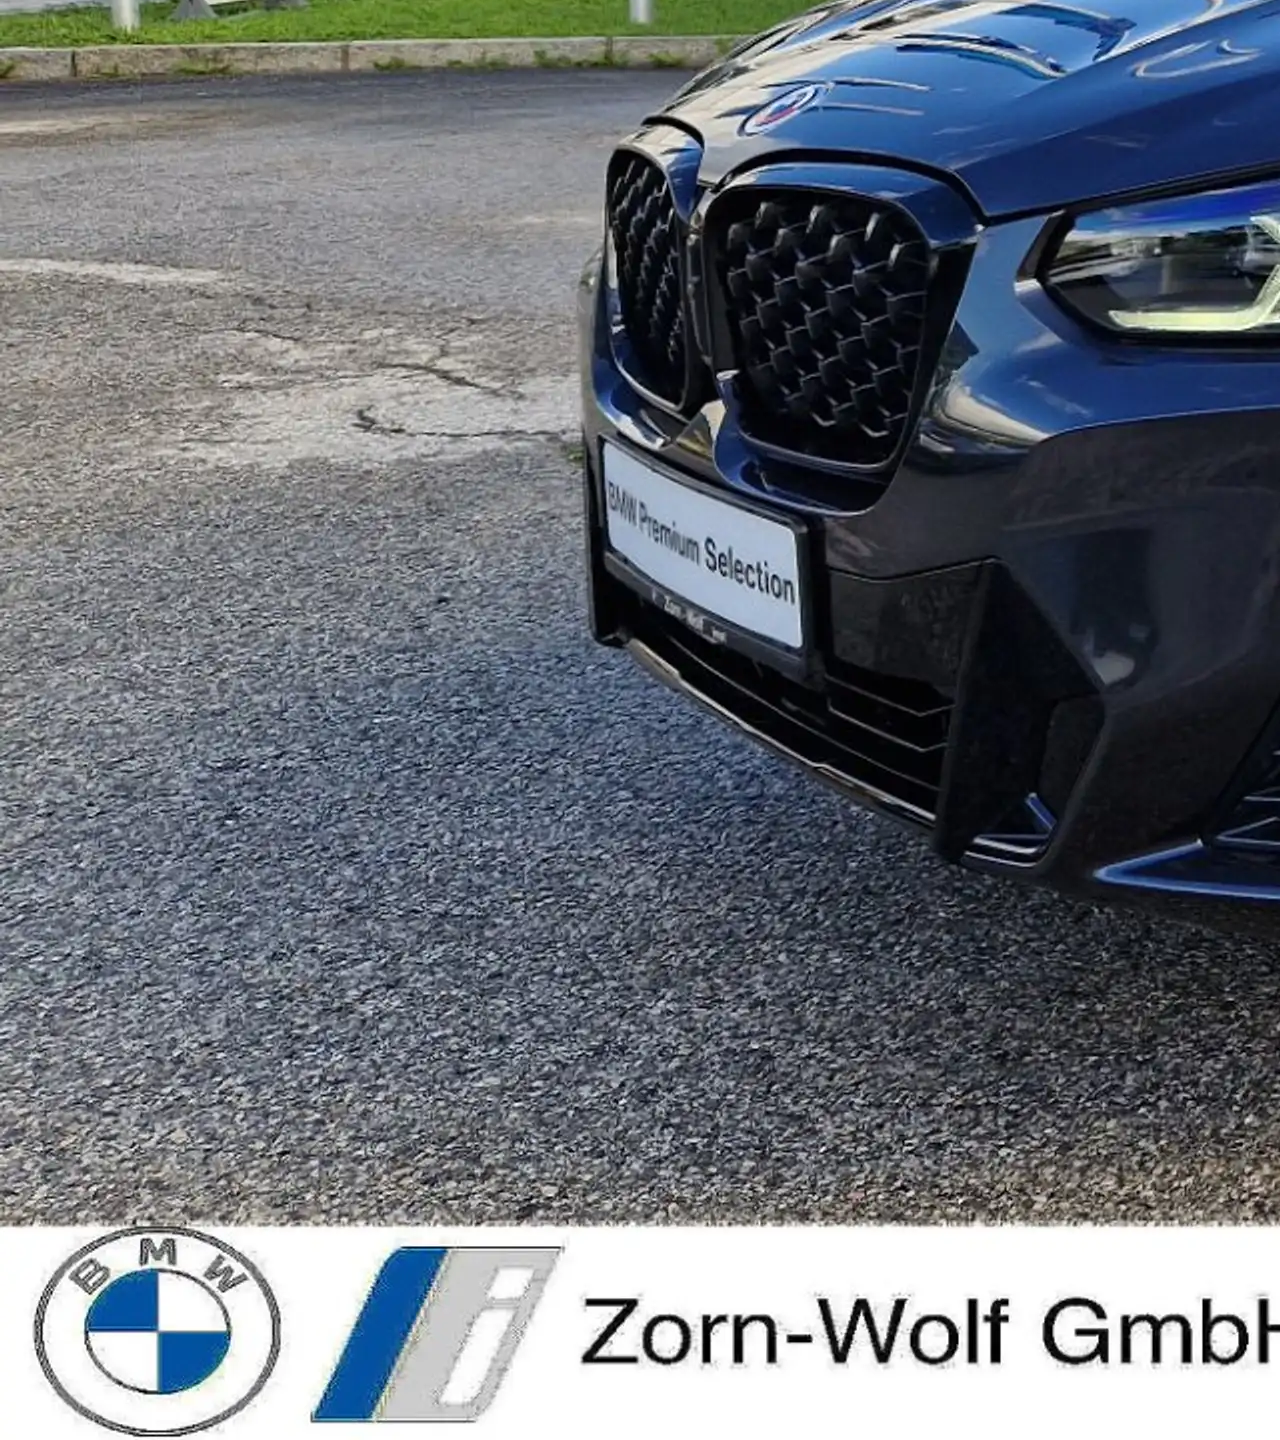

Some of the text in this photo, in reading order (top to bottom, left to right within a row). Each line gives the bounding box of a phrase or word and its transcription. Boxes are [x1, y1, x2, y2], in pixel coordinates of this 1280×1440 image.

[607, 481, 796, 604] BMW Premium Selection
